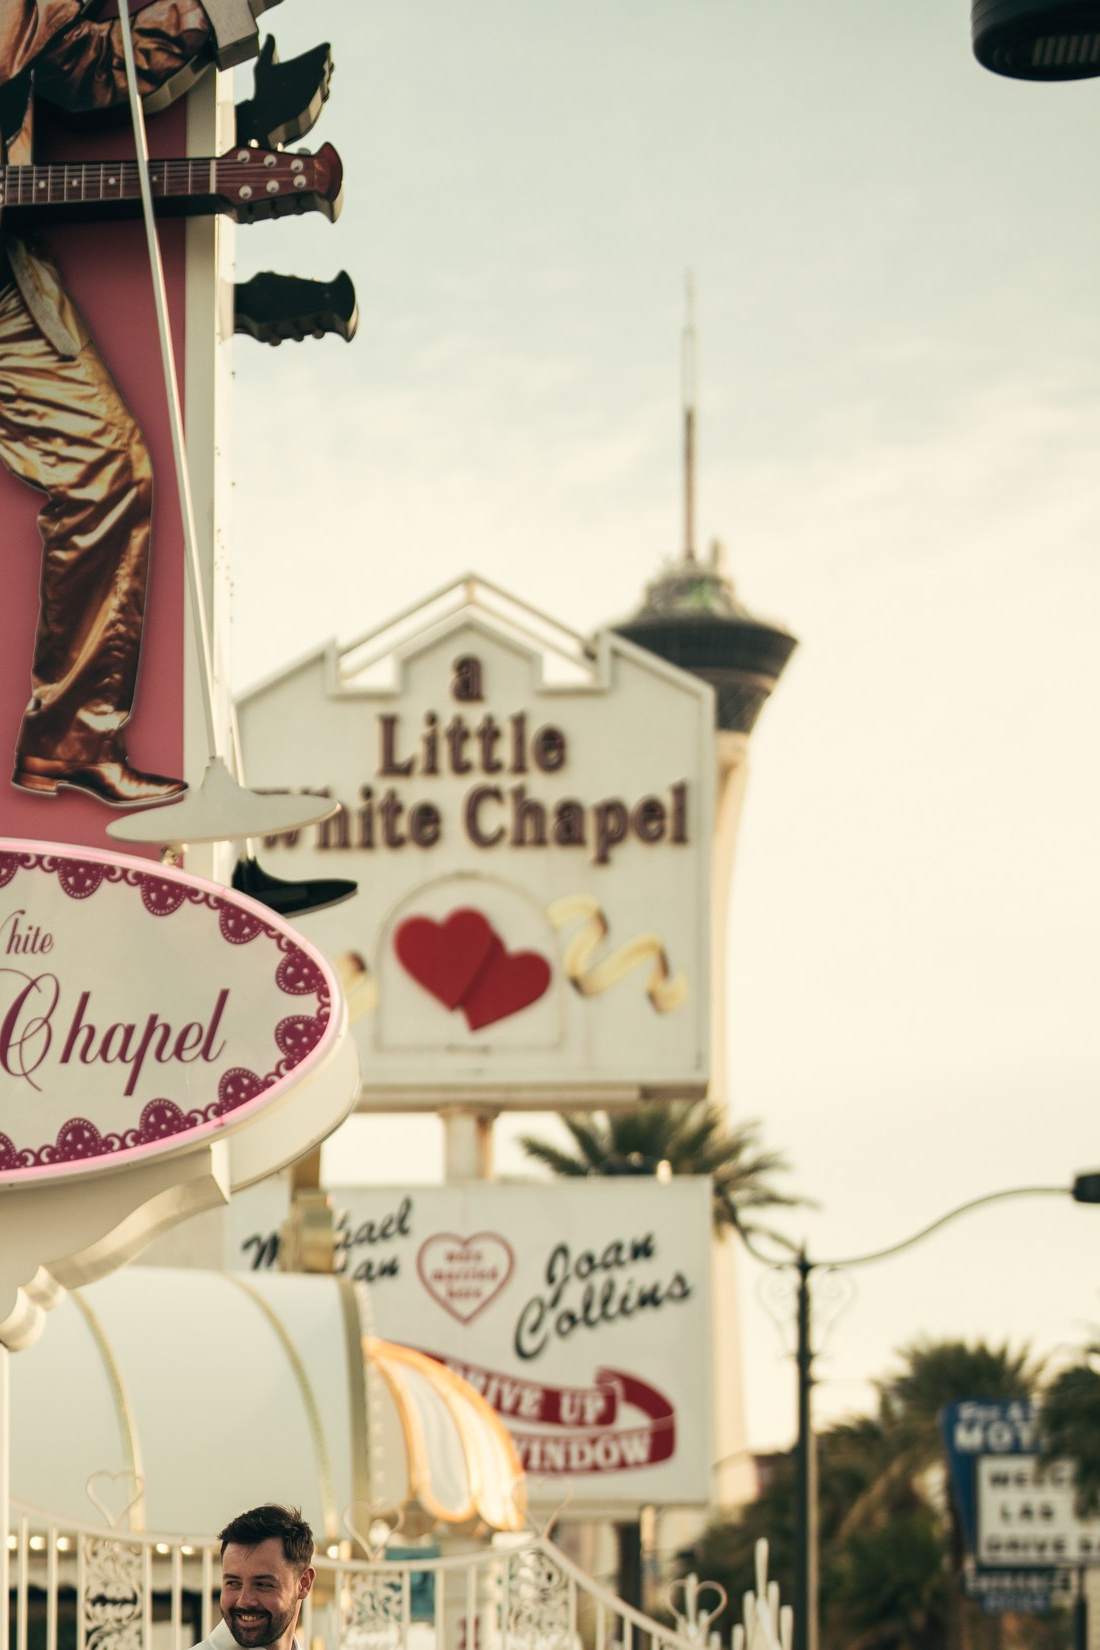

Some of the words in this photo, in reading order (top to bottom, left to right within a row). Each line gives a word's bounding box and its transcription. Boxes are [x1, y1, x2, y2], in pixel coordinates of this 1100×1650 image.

[451, 655, 483, 701] a
[377, 711, 566, 777] Little
[250, 784, 442, 850] hite
[462, 780, 691, 864] Chapel
[545, 1231, 656, 1310] Joan
[513, 1270, 692, 1361] Collins
[560, 1390, 606, 1425] UP
